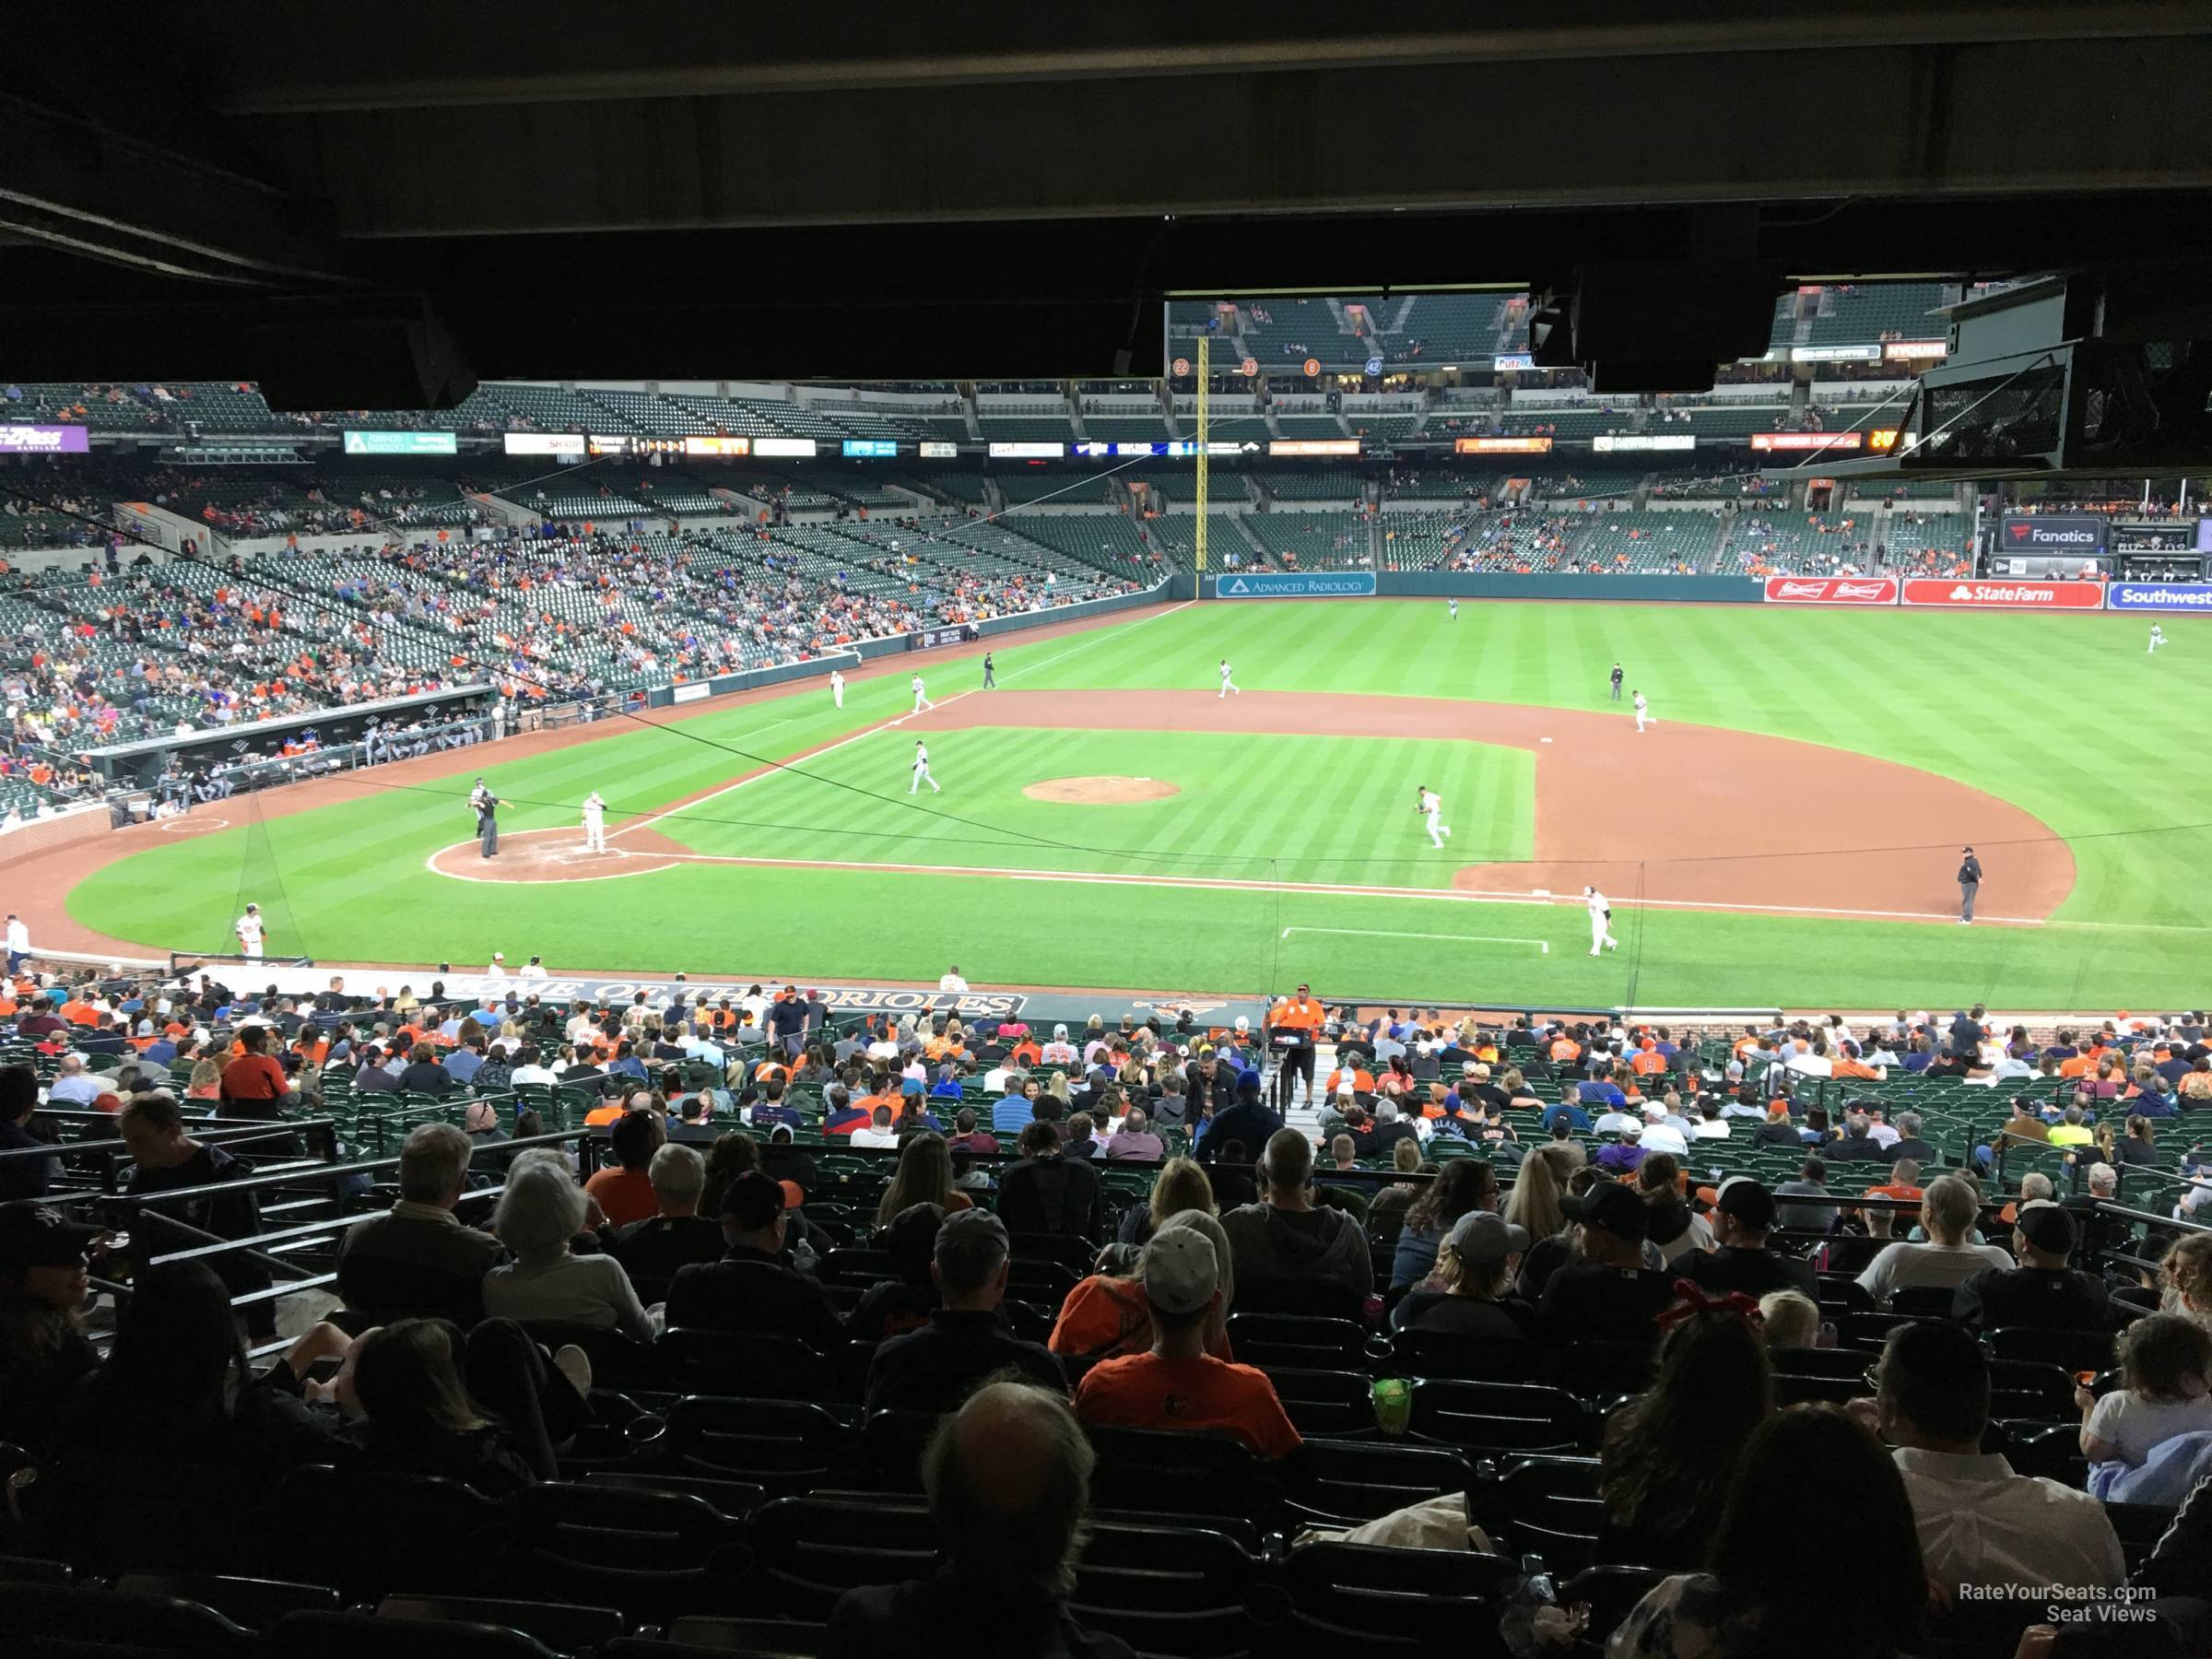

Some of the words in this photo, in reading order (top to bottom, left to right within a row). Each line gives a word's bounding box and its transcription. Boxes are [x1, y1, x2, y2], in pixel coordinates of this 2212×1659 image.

[1175, 363, 1187, 371] 22
[1244, 363, 1256, 371] 33
[1309, 363, 1315, 371] 8
[1368, 362, 1380, 371] 42
[2032, 529, 2095, 543] Fanatics
[2122, 588, 2212, 605] Southwest
[594, 982, 668, 1000] OF
